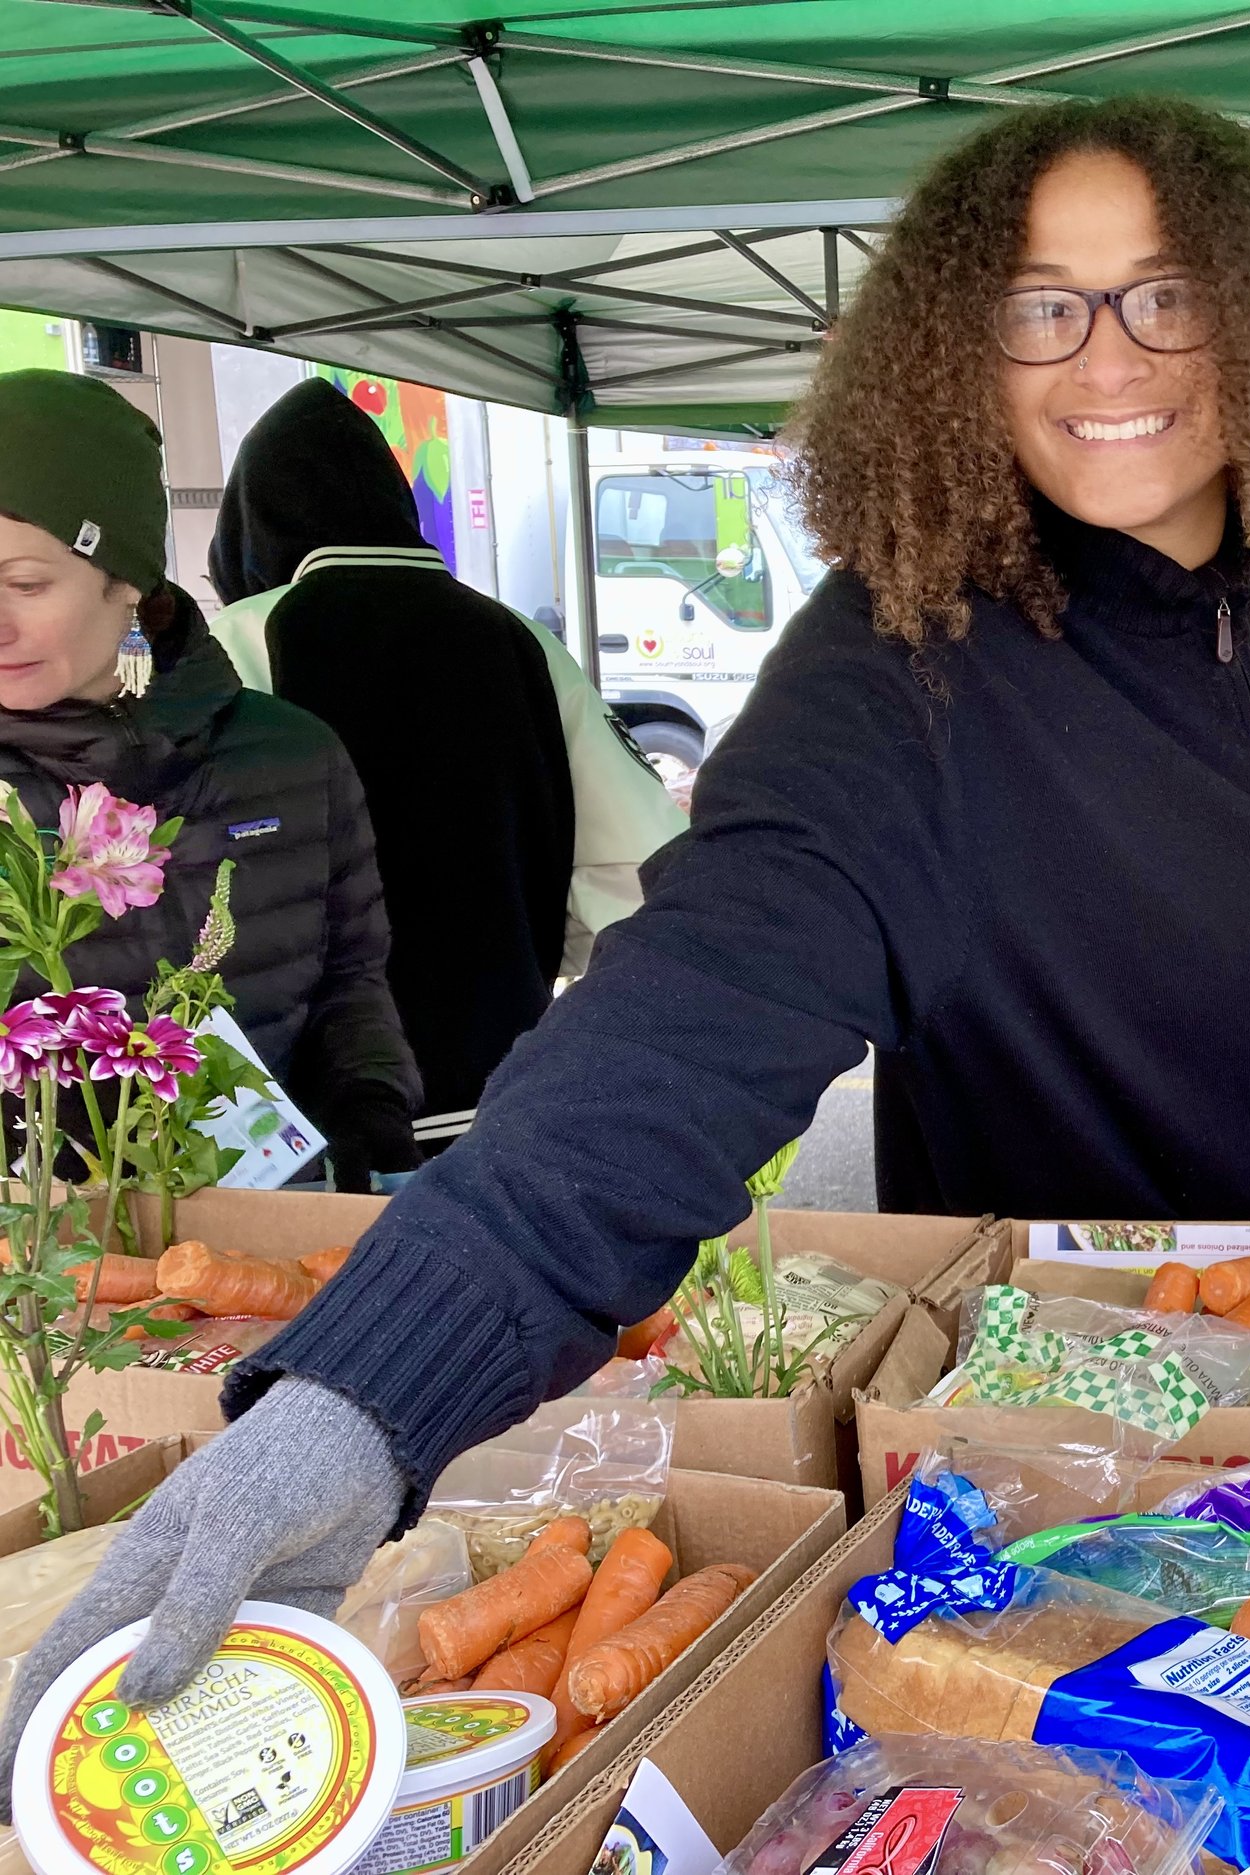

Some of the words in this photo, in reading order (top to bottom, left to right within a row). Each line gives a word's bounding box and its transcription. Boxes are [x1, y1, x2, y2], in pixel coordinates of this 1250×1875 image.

[683, 643, 714, 660] soul
[692, 673, 728, 681] ISUZU
[1180, 1243, 1196, 1251] and
[1198, 1243, 1225, 1252] Onions
[1010, 1537, 1036, 1556] Recipe
[1165, 1653, 1216, 1686] Nutrition
[1212, 1635, 1245, 1657] Facts
[1199, 1664, 1221, 1684] servings
[1208, 1676, 1221, 1689] size
[1226, 1667, 1233, 1675] 2
[1231, 1657, 1249, 1673] slices
[148, 1664, 257, 1725] SRIRACHA
[157, 1685, 252, 1739] HUMMUS
[91, 1708, 195, 1874] roots
[233, 1790, 255, 1805] NON
[236, 1796, 258, 1810] GMO
[878, 1799, 893, 1811] NET
[217, 1806, 265, 1835] VERIFIED
[846, 1833, 866, 1850] LBS.
[843, 1832, 885, 1874] California
